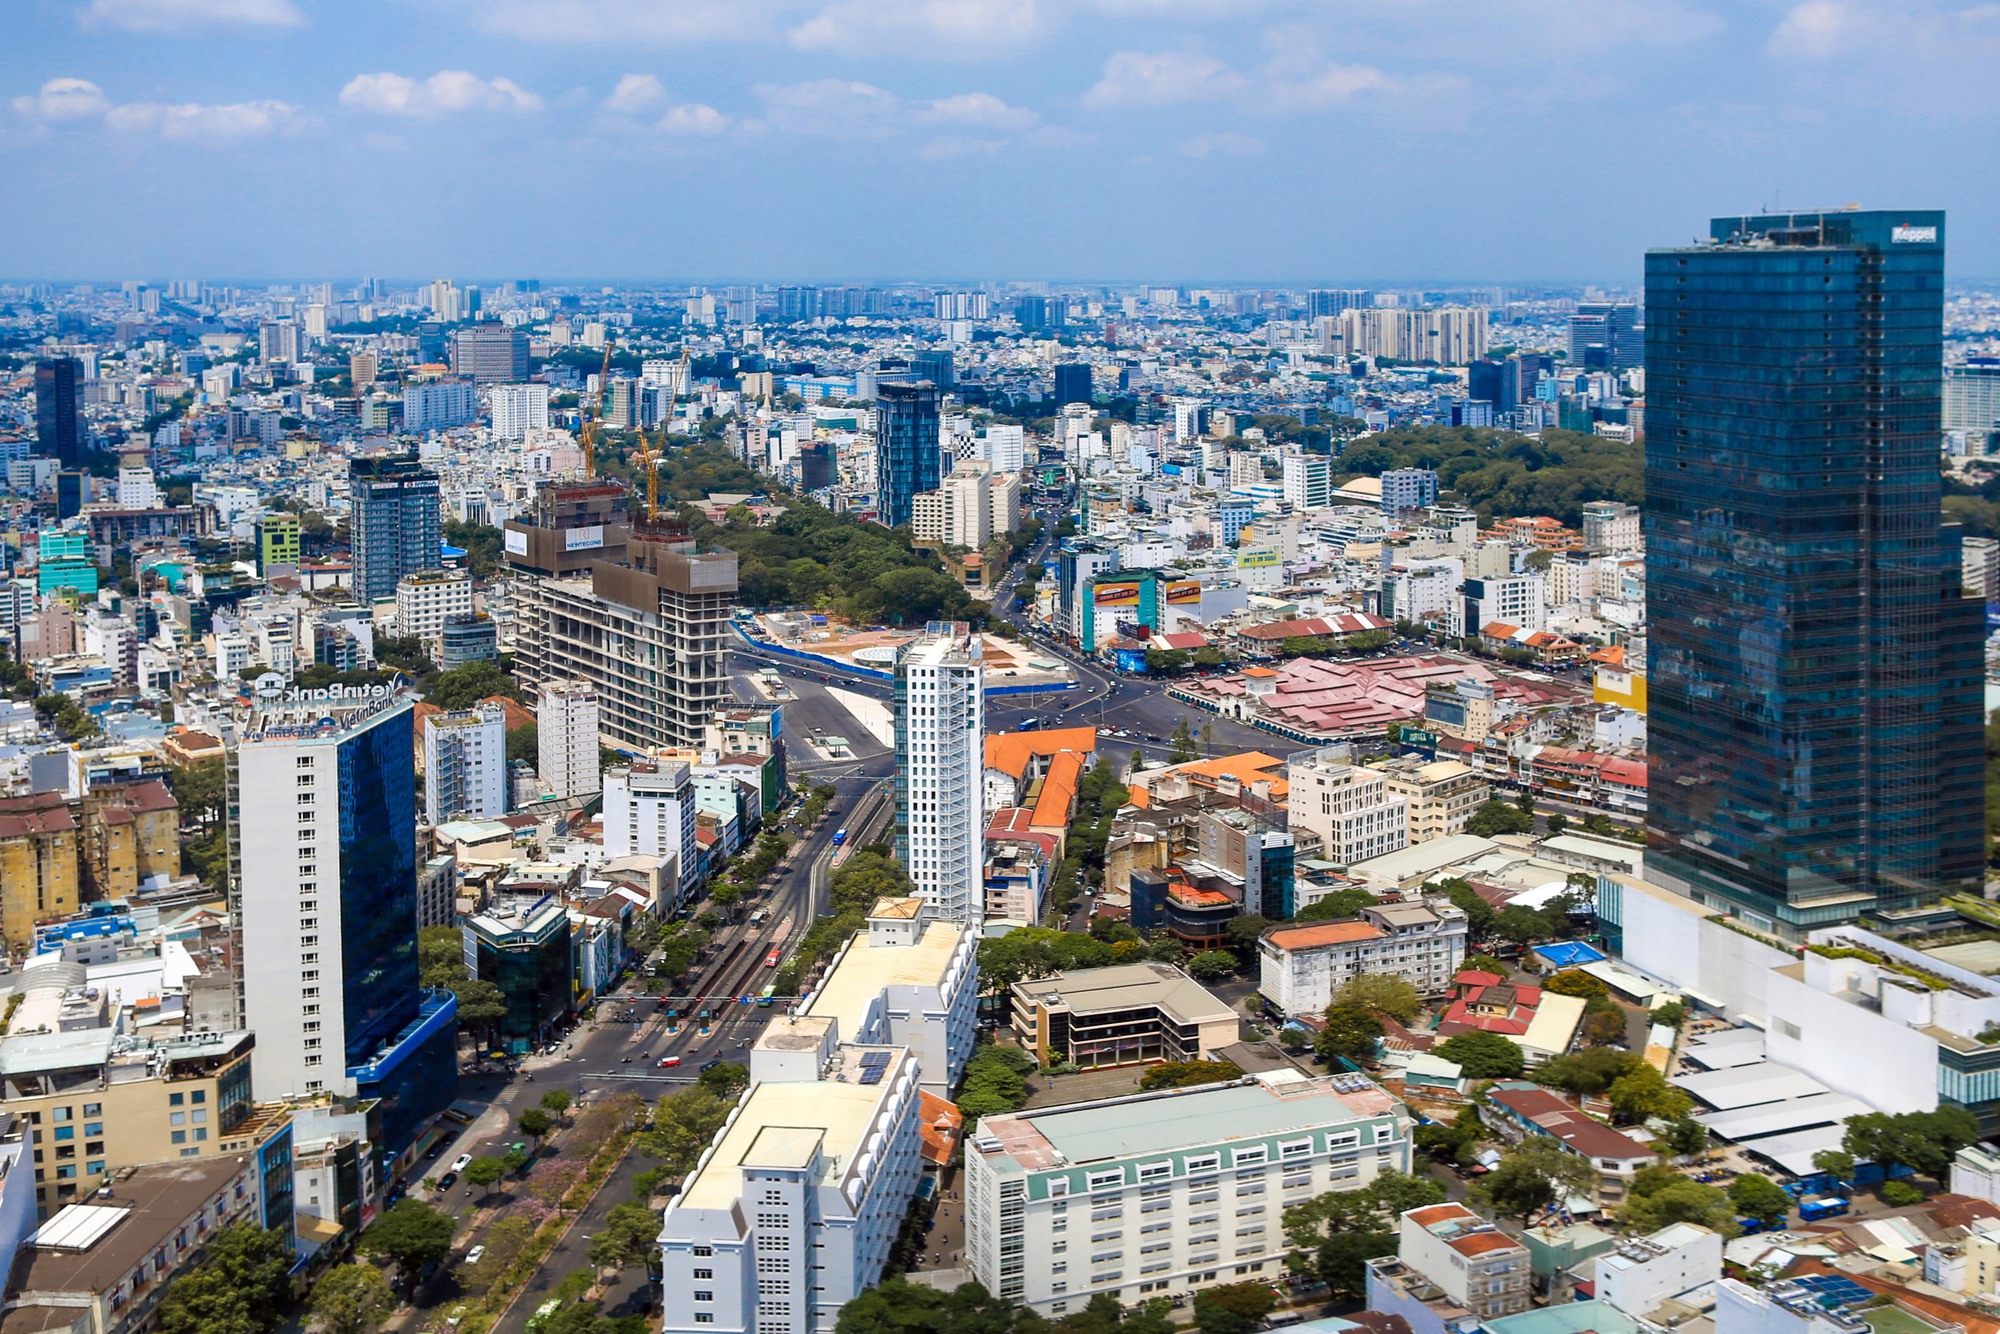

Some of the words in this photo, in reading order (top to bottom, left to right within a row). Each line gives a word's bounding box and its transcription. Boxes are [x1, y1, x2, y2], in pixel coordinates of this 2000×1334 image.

[1892, 225, 1936, 242] Keppel
[567, 540, 602, 548] NEWTECONS
[340, 694, 396, 730] VietinBank
[242, 726, 318, 740] VietinBank
